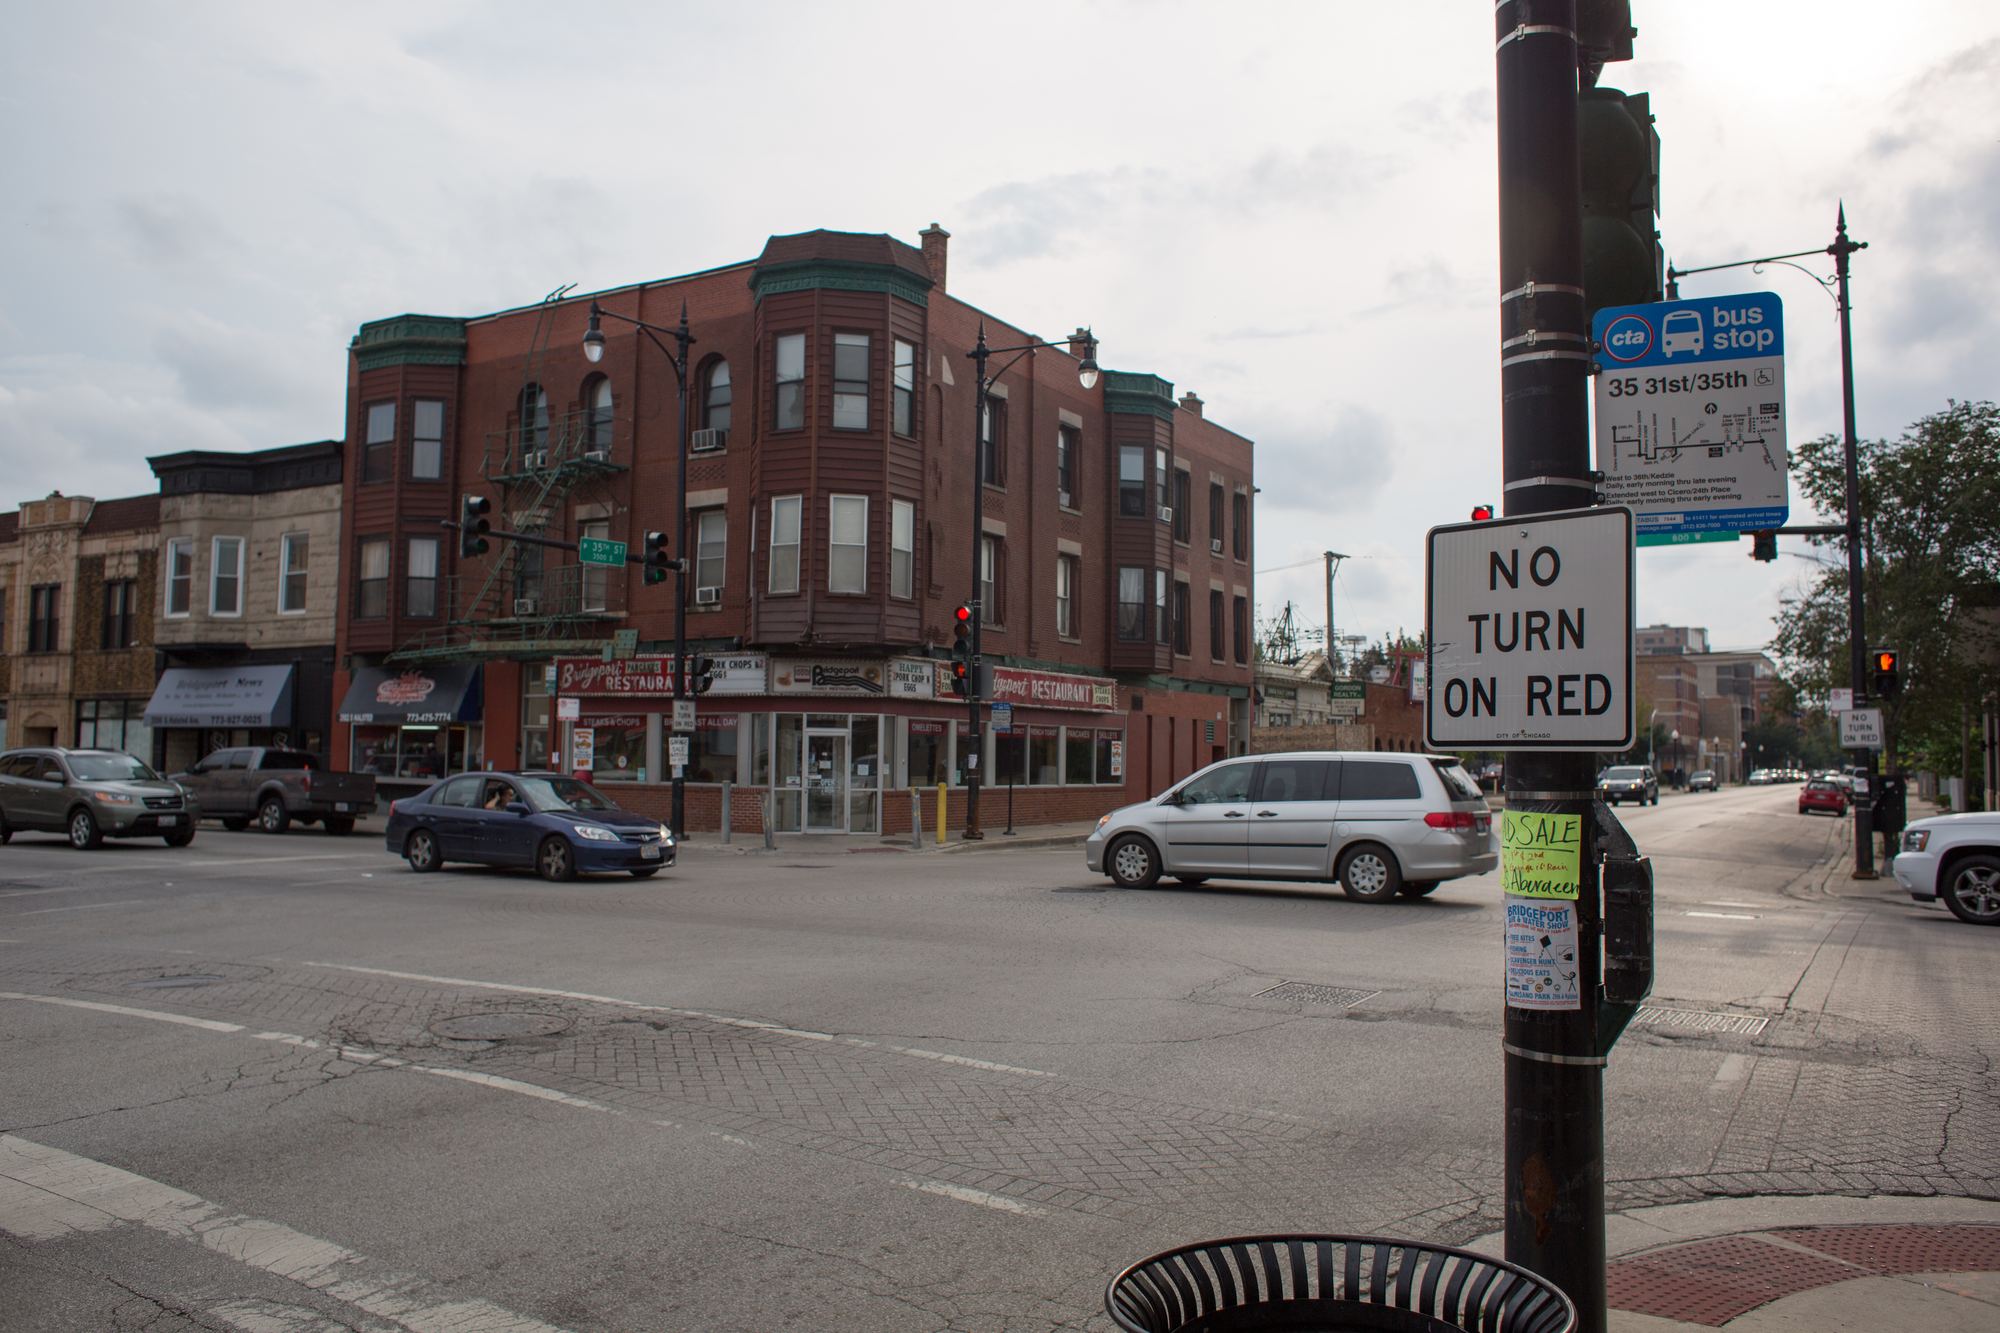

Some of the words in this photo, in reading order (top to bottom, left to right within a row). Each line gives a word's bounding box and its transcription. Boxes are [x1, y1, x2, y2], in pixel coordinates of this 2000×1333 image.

[1713, 306, 1763, 328] bus
[1611, 330, 1647, 347] cta
[1713, 328, 1774, 352] stop
[1608, 378, 1639, 398] 35
[1645, 371, 1748, 394] 31st/35th
[1626, 481, 1644, 489] early
[1708, 475, 1736, 483] evening
[1633, 472, 1675, 481] 36th/Kedzie
[1606, 491, 1639, 499] Extended
[1711, 486, 1731, 494] Place
[1645, 497, 1675, 505] morning
[1693, 494, 1711, 502] early
[1712, 493, 1742, 501] evening
[613, 544, 624, 555] ST
[1490, 546, 1561, 591] NO
[1468, 608, 1585, 654] TURN
[711, 660, 726, 669] ORK
[728, 660, 752, 670] CHOPS
[561, 661, 623, 690] Bridgeport
[812, 665, 860, 686] Bridgeport
[911, 673, 925, 684] CHOP
[606, 674, 692, 691] RESTAURAT
[903, 682, 917, 693] EGGS
[1032, 679, 1091, 703] RESTAURANT
[1444, 676, 1497, 718] ON
[1527, 674, 1612, 717] RED
[1095, 695, 1110, 704] CHOPS
[584, 717, 608, 726] STEAKS
[616, 717, 641, 726] CHOPS
[707, 718, 721, 727] ALL
[722, 718, 738, 727] DAY
[912, 723, 943, 733] OMELETTES
[1848, 723, 1872, 731] TURN
[1844, 734, 1856, 742] ON
[1861, 734, 1878, 742] RED
[1516, 814, 1580, 847] SALE
[1511, 867, 1580, 895] Aberdeen
[1507, 905, 1570, 922] BRIDGEPORT
[1523, 917, 1545, 929] WATER
[1547, 920, 1569, 930] SHOW
[1535, 969, 1551, 977] EATS
[1535, 992, 1551, 1000] PARK
